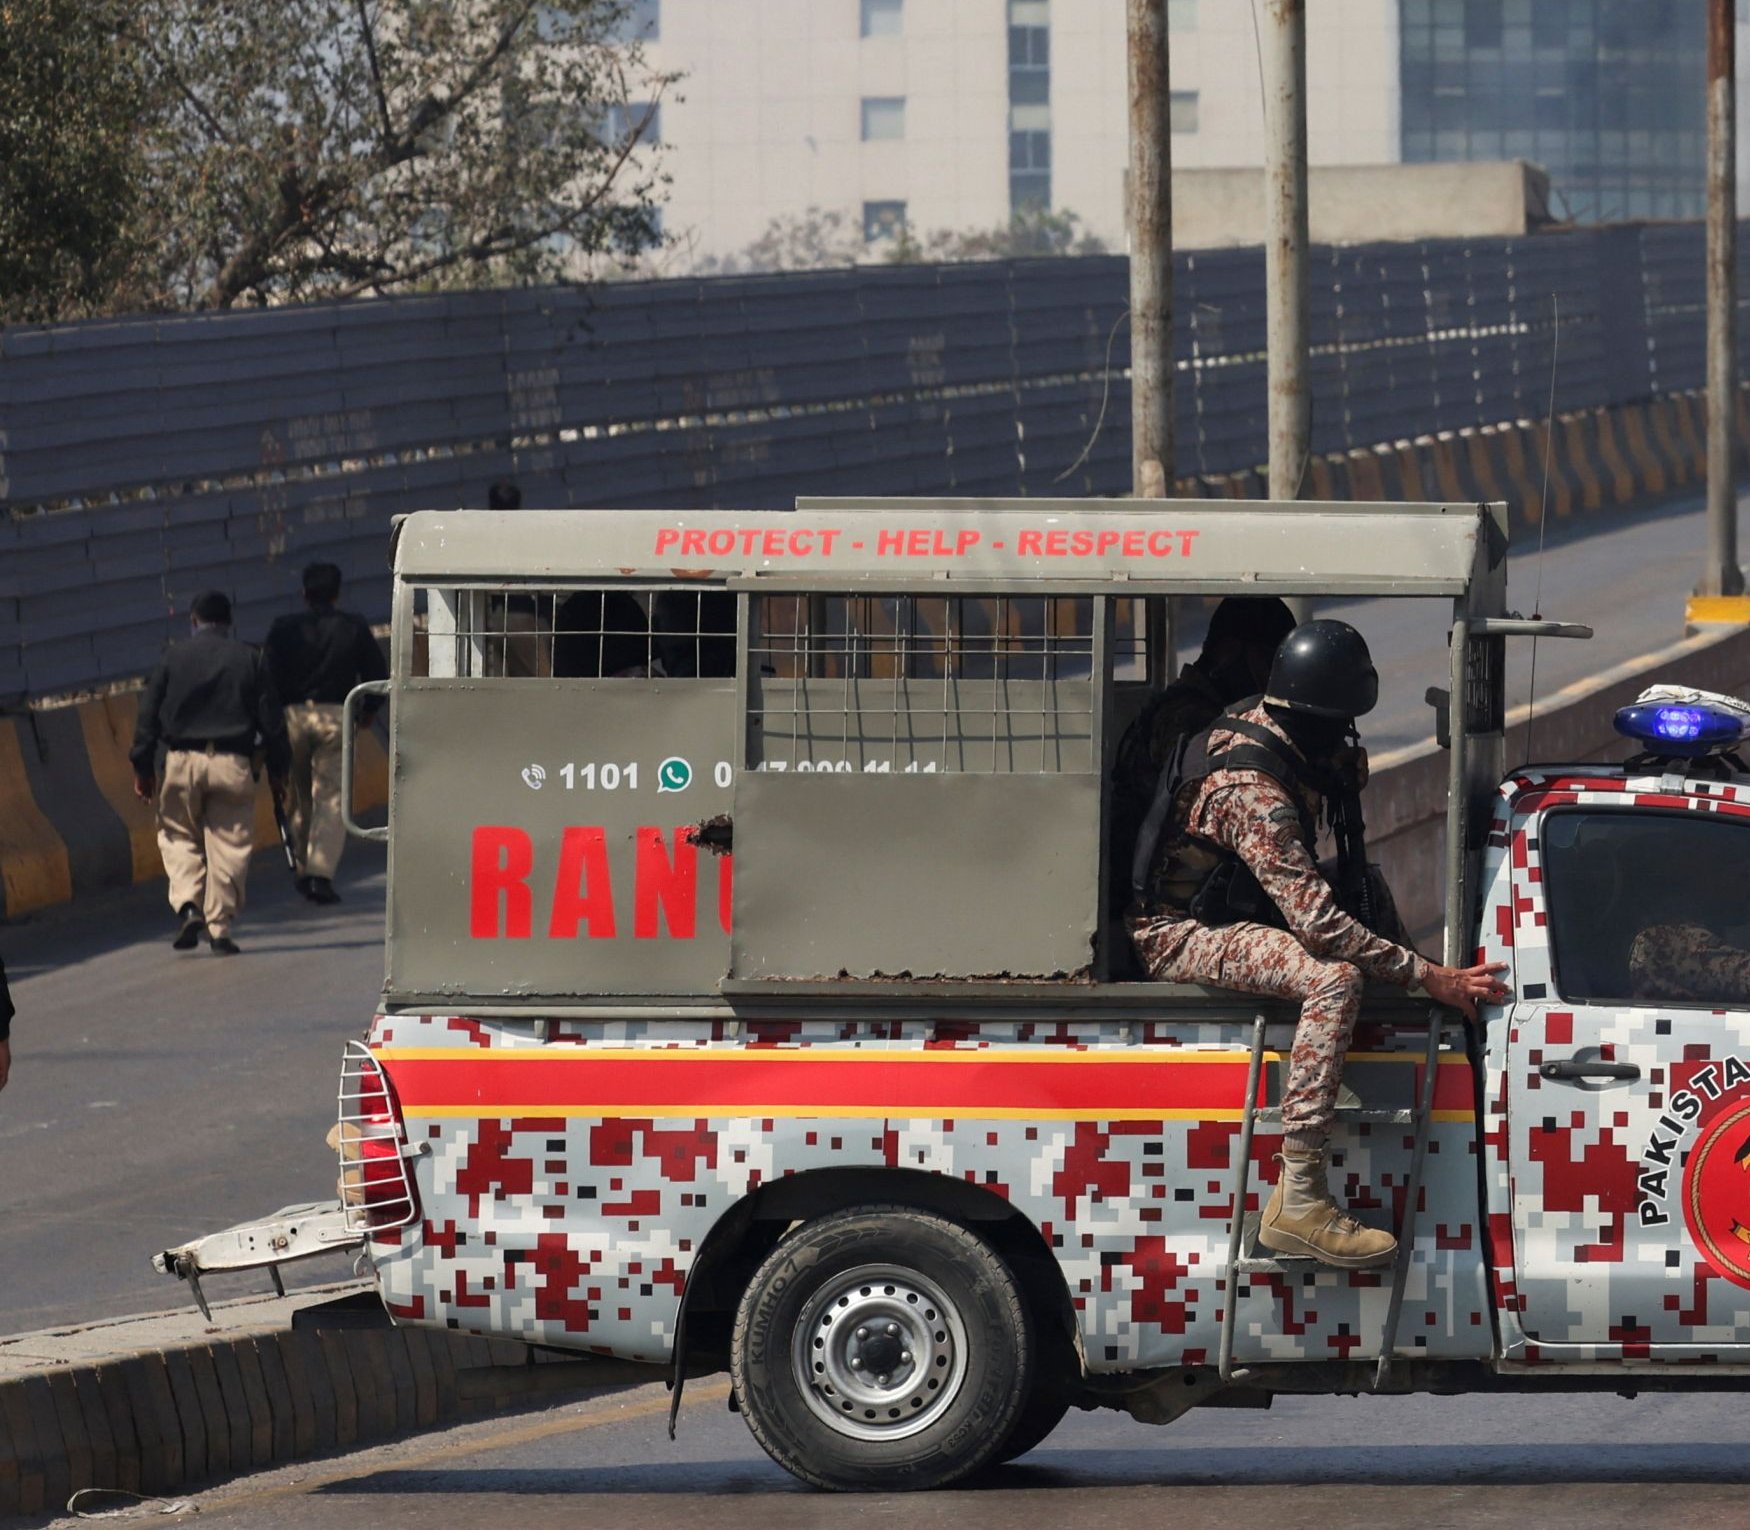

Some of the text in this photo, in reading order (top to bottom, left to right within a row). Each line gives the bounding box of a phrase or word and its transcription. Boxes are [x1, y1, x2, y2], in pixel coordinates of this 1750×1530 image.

[655, 529, 841, 556] PROTECT
[876, 529, 981, 556] HELP
[1016, 530, 1201, 557] RESPECT
[559, 763, 639, 789] 1101
[470, 825, 734, 939] RAN
[751, 1276, 786, 1365] KUMHO
